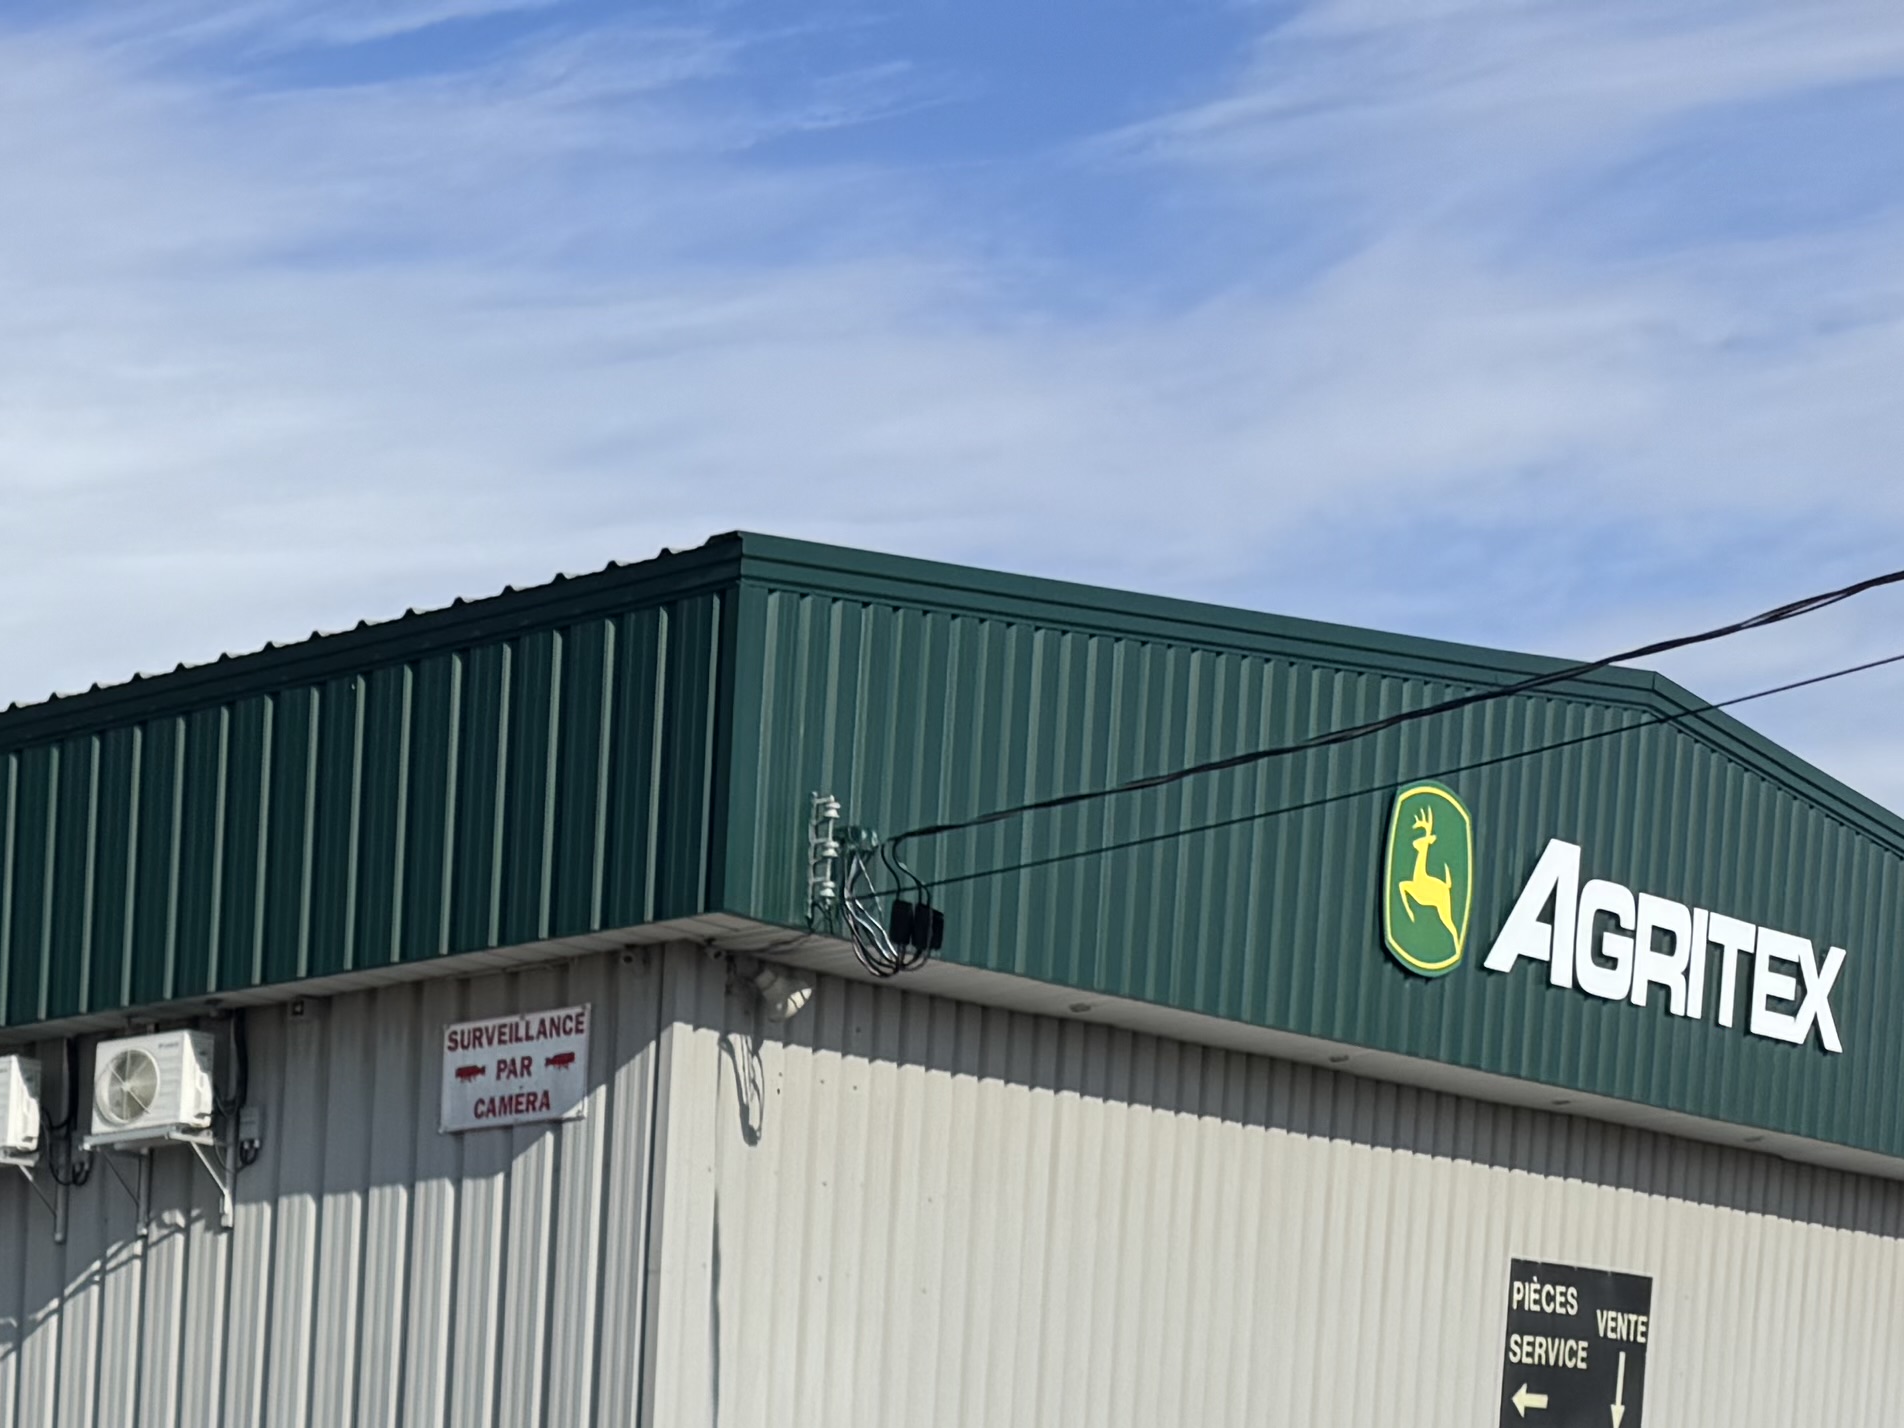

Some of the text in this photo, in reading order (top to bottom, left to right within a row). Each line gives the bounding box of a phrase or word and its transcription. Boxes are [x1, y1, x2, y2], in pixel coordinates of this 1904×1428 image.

[1483, 837, 1847, 1054] AGRITEX
[447, 1011, 585, 1052] SURVEILLANCE
[496, 1056, 533, 1081] PAR
[1512, 1275, 1578, 1316] PIÈCES
[1596, 1309, 1648, 1343] VENTE
[1509, 1334, 1589, 1369] SERVICE
